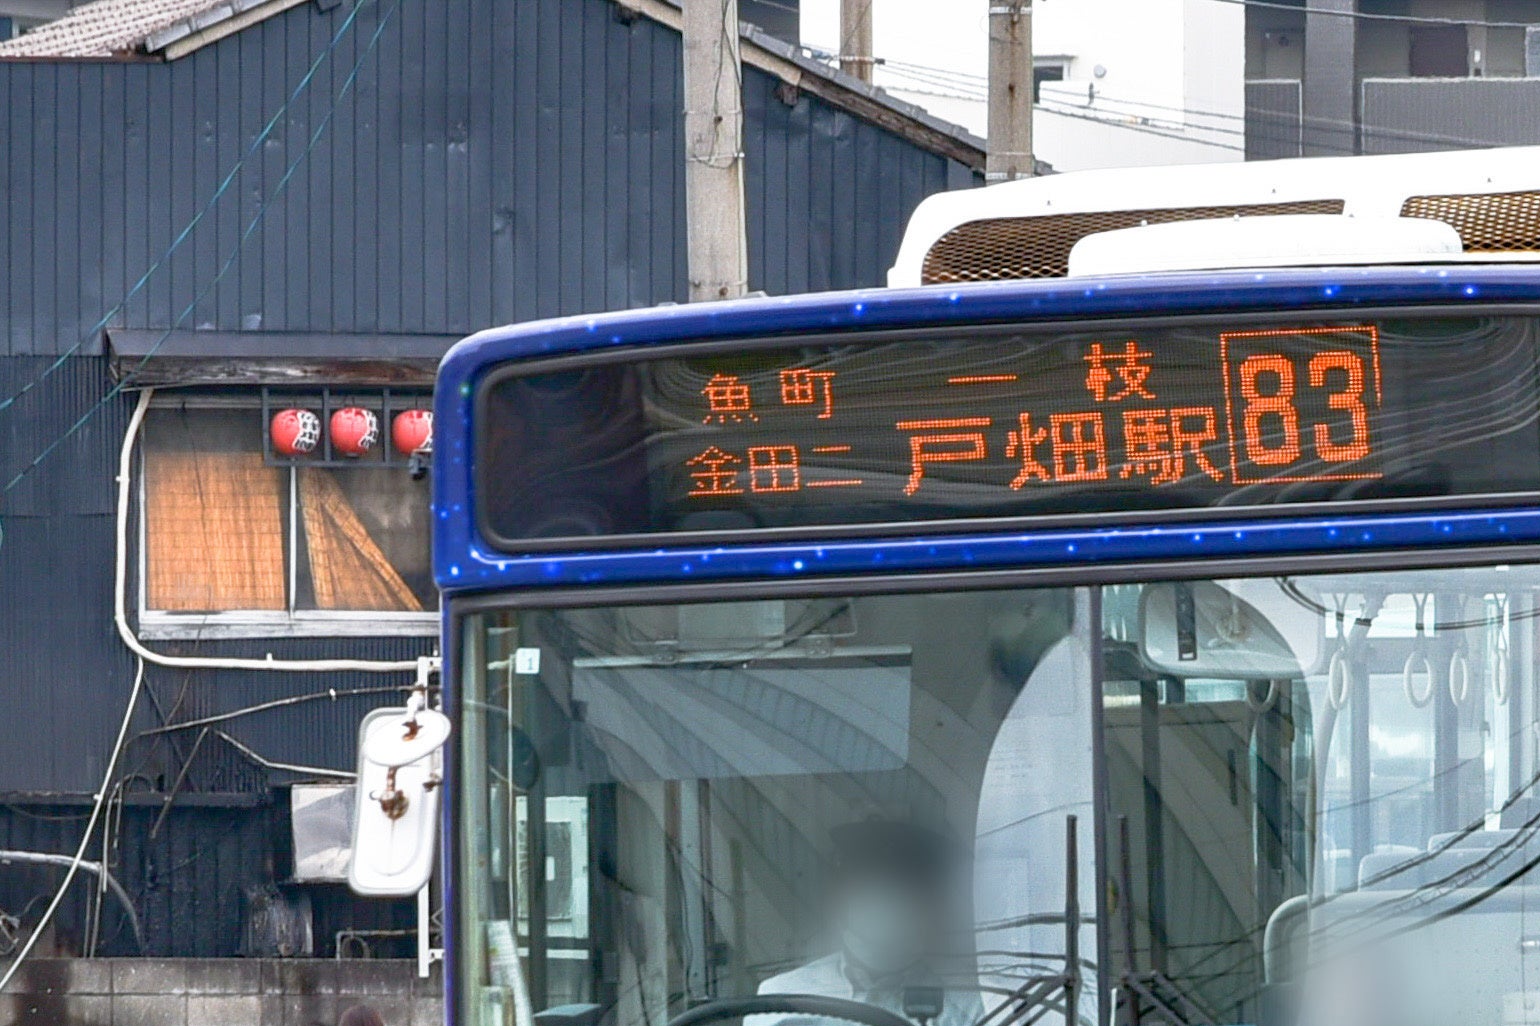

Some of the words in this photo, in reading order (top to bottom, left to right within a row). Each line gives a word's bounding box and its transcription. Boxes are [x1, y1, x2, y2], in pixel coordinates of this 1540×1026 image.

[701, 368, 837, 424] 魚町
[1239, 350, 1370, 466] 83
[685, 445, 863, 497] 金田二
[896, 406, 1225, 496] 戸畑駅
